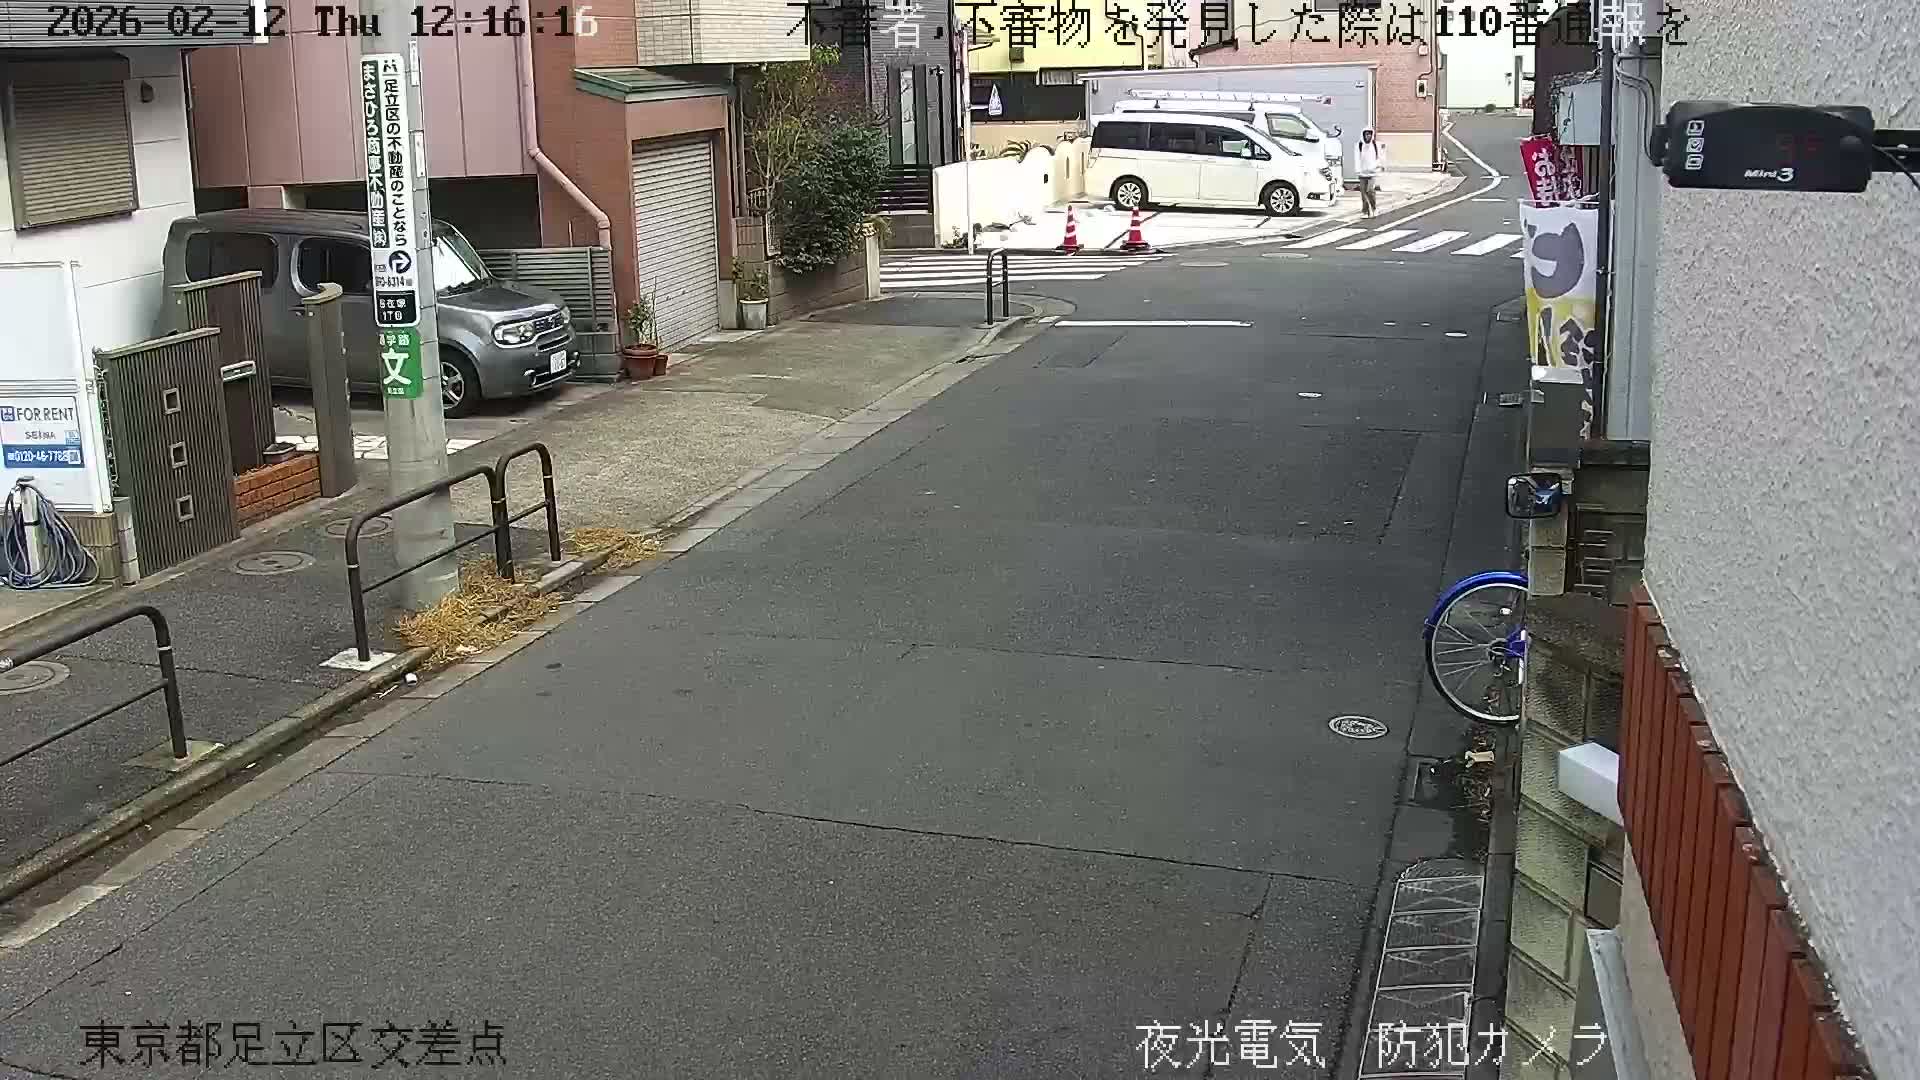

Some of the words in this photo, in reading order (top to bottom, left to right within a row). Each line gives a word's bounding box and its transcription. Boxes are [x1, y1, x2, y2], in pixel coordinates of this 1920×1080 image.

[384, 79, 407, 246] 足立区の不動産のことなら
[381, 347, 412, 385] 文
[16, 407, 41, 421] FOR
[43, 407, 74, 421] RENT
